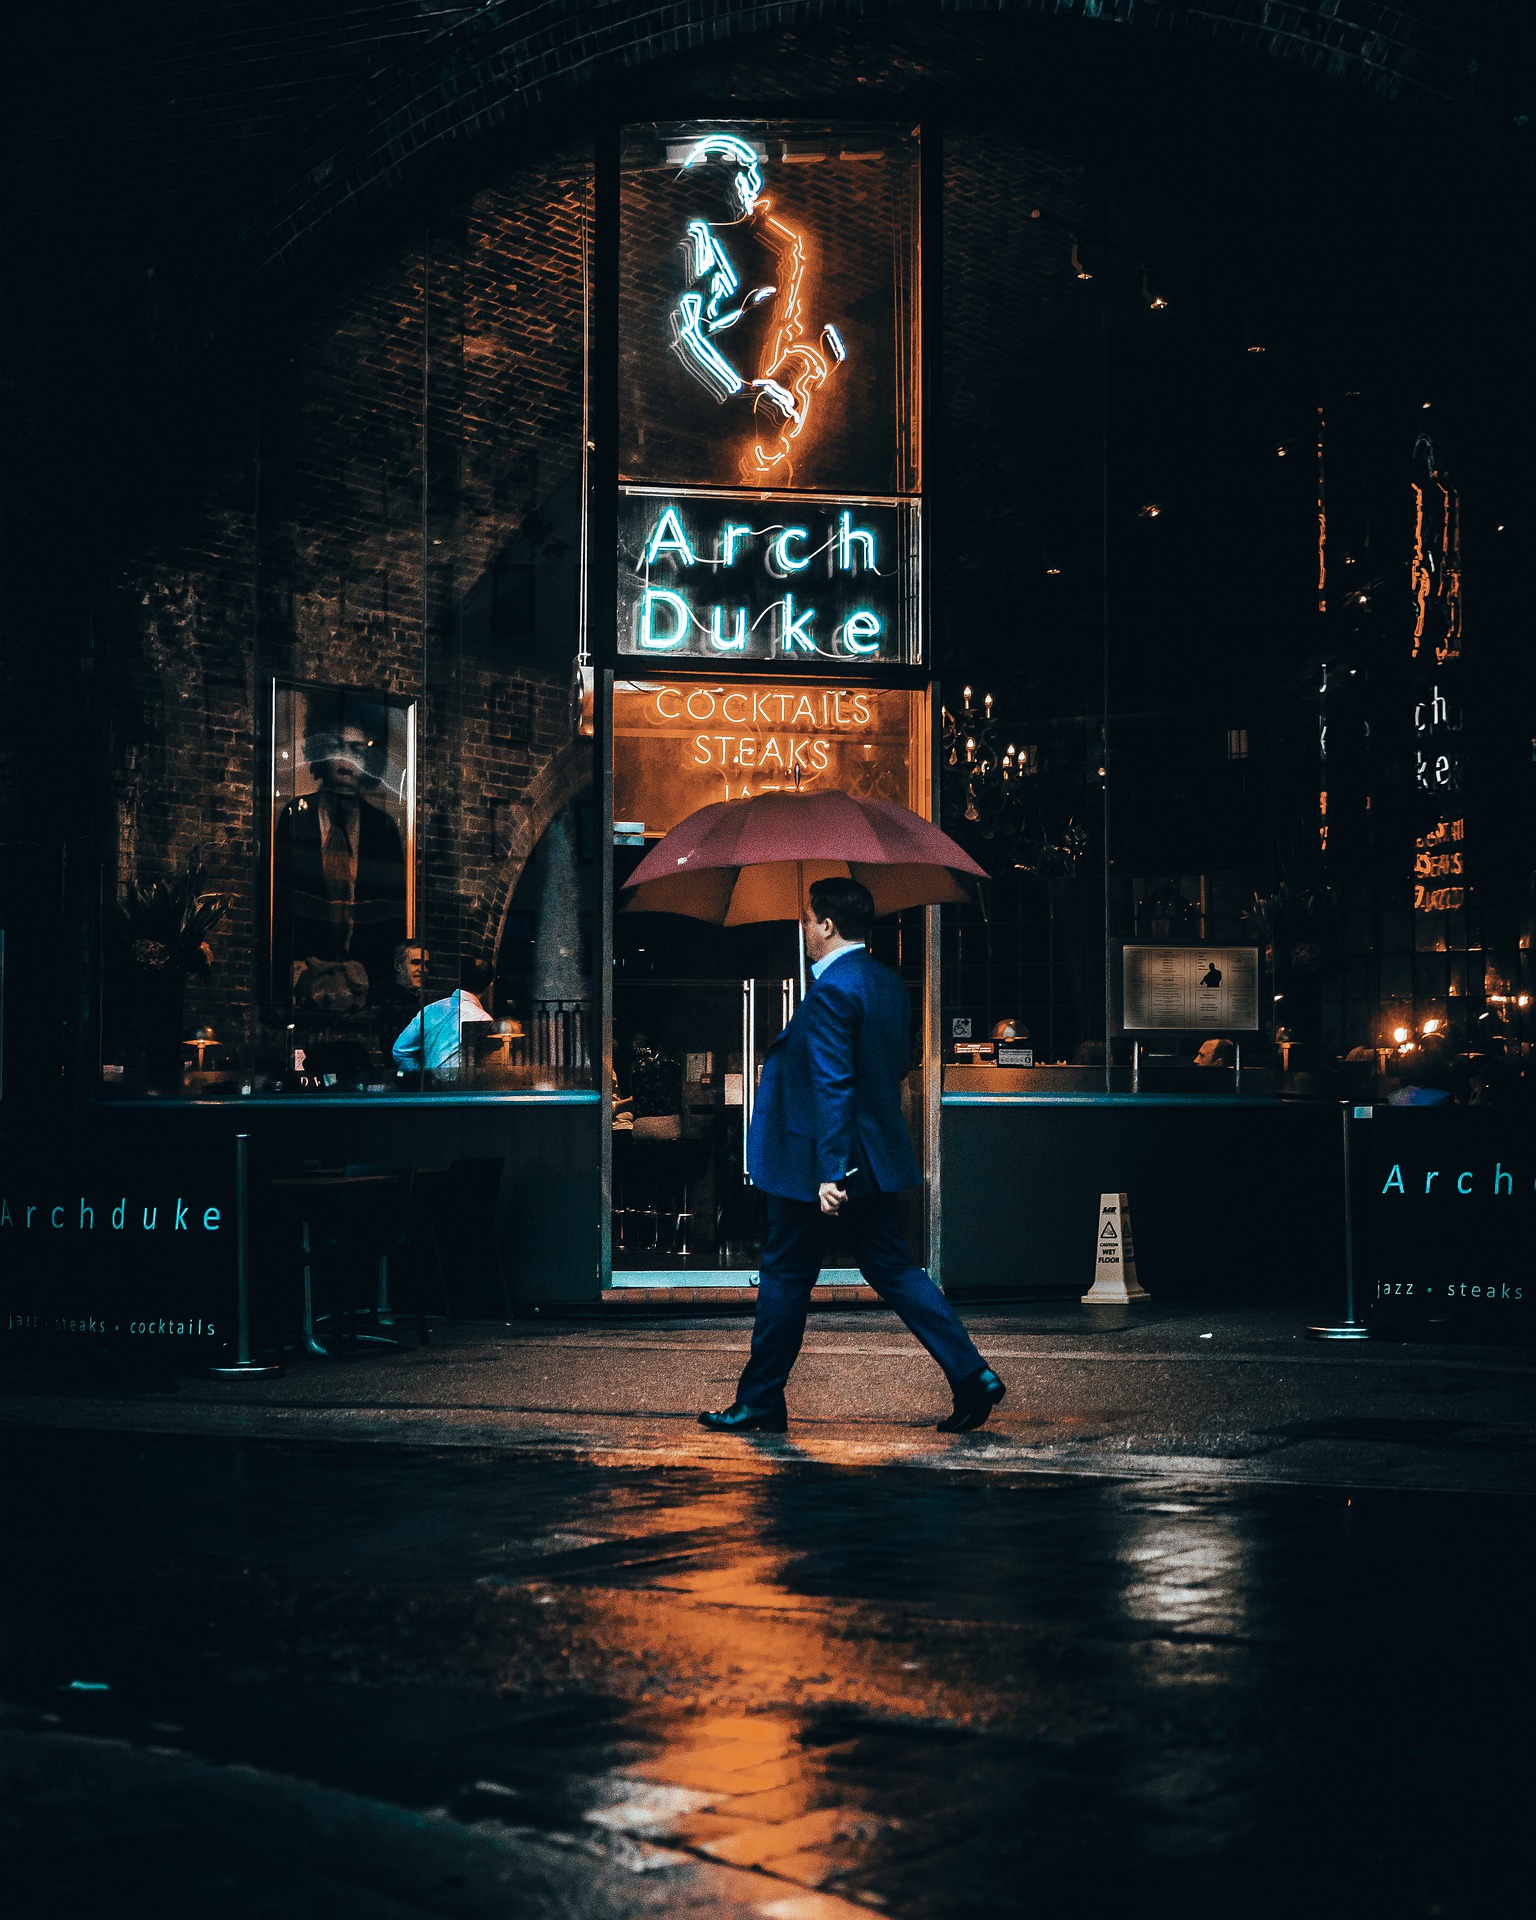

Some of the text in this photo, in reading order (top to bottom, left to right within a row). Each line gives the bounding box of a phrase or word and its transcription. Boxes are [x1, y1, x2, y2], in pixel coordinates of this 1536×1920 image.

[648, 507, 875, 570] Arch
[642, 589, 880, 652] Duke
[655, 688, 870, 724] COCKTAILS
[694, 734, 830, 770] STEAKS
[1381, 1162, 1536, 1196] Arch
[1, 1197, 221, 1231] Archduke
[1376, 1280, 1523, 1300] jazz steaks
[8, 1311, 215, 1336] jazz steaks cocktails
